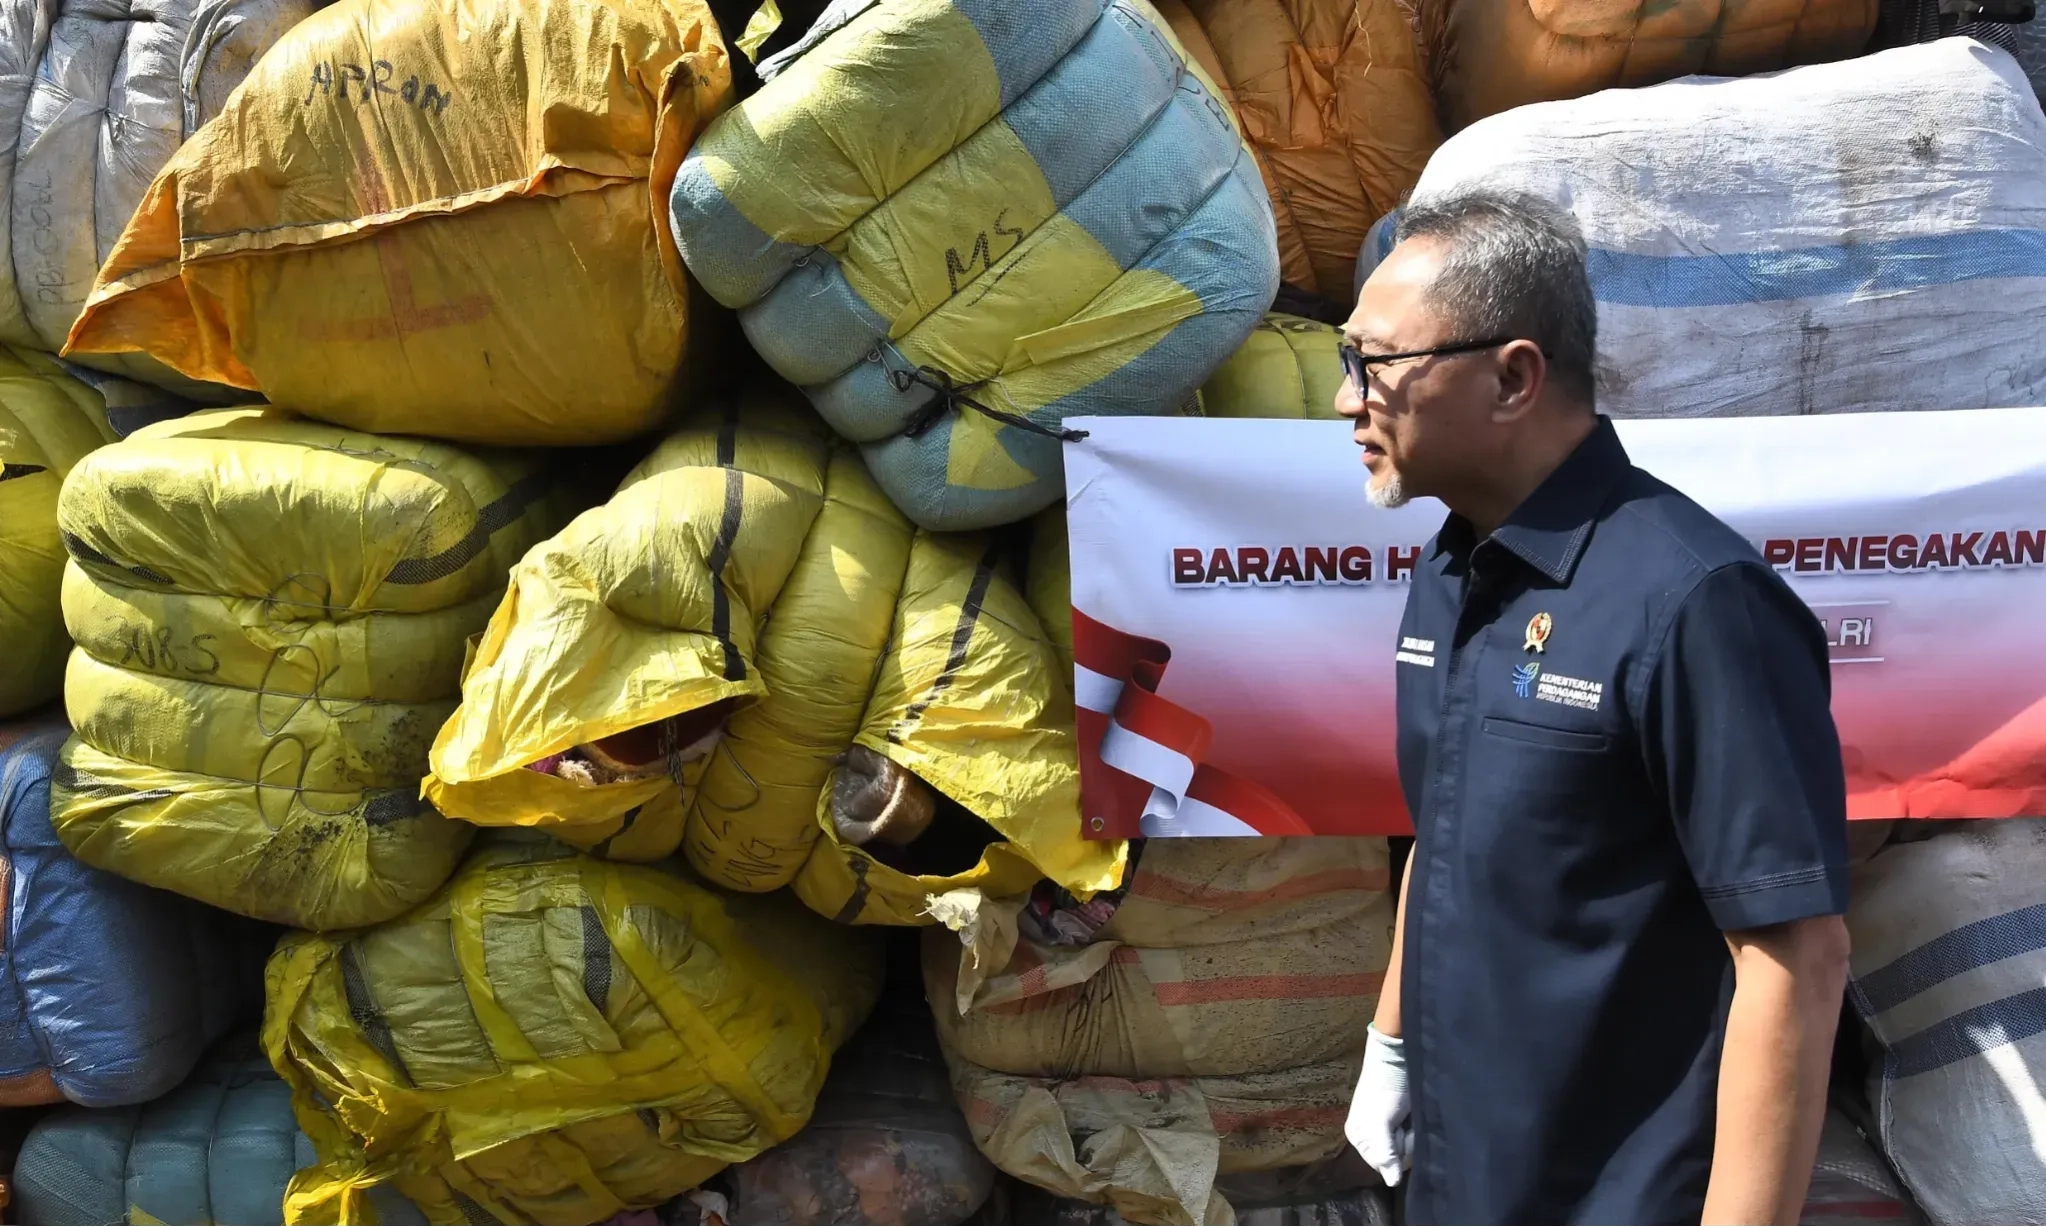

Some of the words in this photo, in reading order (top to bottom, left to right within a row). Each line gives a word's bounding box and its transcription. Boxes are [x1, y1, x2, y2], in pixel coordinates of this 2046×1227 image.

[1173, 546, 1372, 584] BARANG
[1387, 545, 1421, 581] H
[1763, 530, 2046, 572] PENEGAKAN
[1820, 617, 1872, 647] LRI
[1537, 682, 1600, 704] PERDAGANGAN
[1539, 673, 1602, 693] KEMENTERIAN
